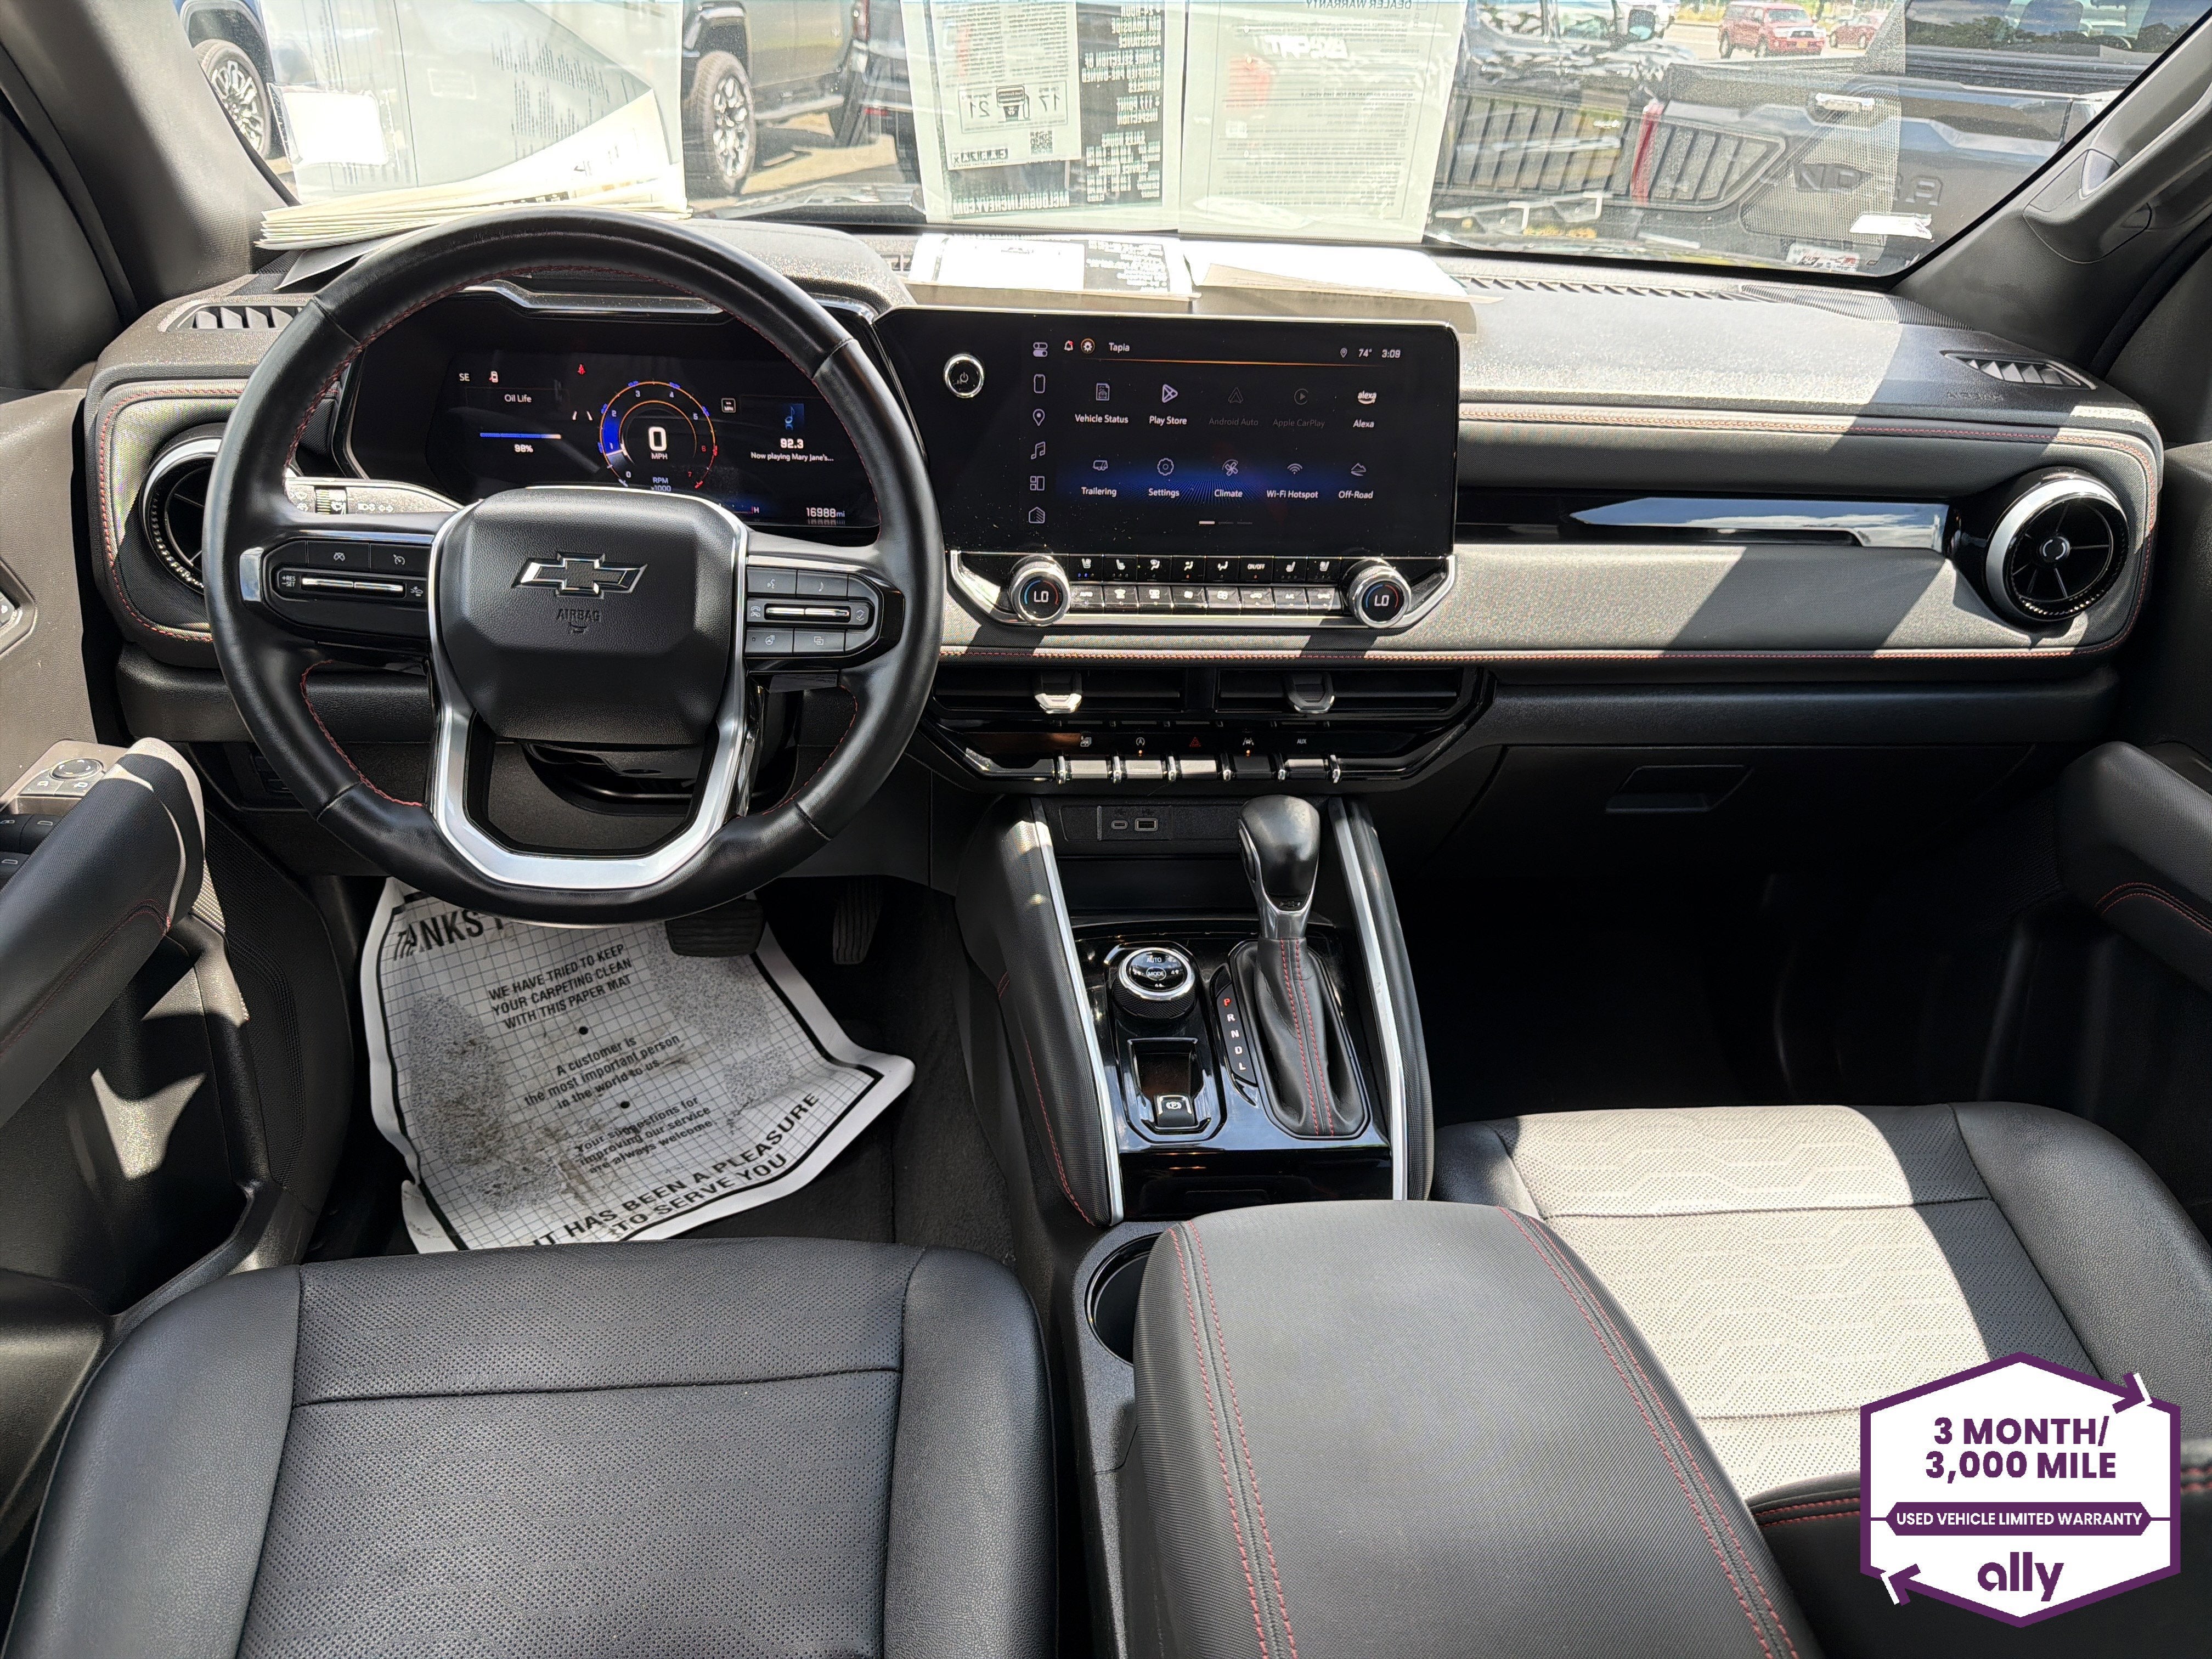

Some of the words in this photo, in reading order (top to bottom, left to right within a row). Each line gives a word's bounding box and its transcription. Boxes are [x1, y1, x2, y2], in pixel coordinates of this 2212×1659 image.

[1109, 342, 1130, 353] Tapia
[1382, 349, 1401, 358] 3:09
[459, 373, 470, 381] SE
[504, 394, 516, 402] Oil
[517, 394, 532, 403] Life
[1357, 390, 1377, 399] alexa
[1075, 414, 1102, 423] Vehicle
[1104, 414, 1128, 424] Status
[1149, 415, 1165, 426] Play
[1166, 416, 1187, 425] Store
[1209, 417, 1239, 426] Android
[1240, 418, 1259, 426] Auto
[1273, 419, 1294, 428] Apple
[1296, 419, 1325, 429] CarPlay
[1353, 419, 1375, 428] Alexa
[648, 427, 667, 452] 0
[780, 438, 804, 449] 92.3
[514, 444, 533, 453] 98%
[751, 452, 766, 460] Now
[768, 452, 791, 461] playing
[792, 454, 808, 462] Mary
[1081, 487, 1117, 498] Trailering
[1148, 488, 1180, 499] Settings
[1214, 489, 1243, 498] Climate
[1266, 489, 1286, 498] Wi-Fi
[1288, 490, 1318, 500] Hotspot
[1338, 490, 1374, 499] Off-Road
[1034, 591, 1048, 602] LO
[1374, 595, 1390, 607] LO
[556, 608, 600, 622] AIRBAG
[488, 985, 511, 1001] WE
[512, 974, 545, 994] HAVE
[546, 962, 578, 982] TRIED
[579, 955, 595, 968] TO
[597, 944, 624, 961] KEEP
[491, 997, 528, 1016] YOUR
[531, 972, 594, 1004] CARPETING
[595, 958, 632, 979] CLEAN
[503, 1011, 537, 1029] WITH
[538, 999, 567, 1018] THIS
[568, 985, 606, 1006] PAPER
[607, 974, 631, 991] MAT
[1223, 998, 1231, 1006] P
[1227, 1014, 1235, 1022] R
[1231, 1030, 1239, 1038] N
[1235, 1046, 1243, 1054] D
[1239, 1062, 1246, 1070] L
[557, 1065, 567, 1076] A
[568, 1042, 623, 1070] customer
[624, 1036, 637, 1047] is
[524, 1091, 544, 1107] the
[548, 1077, 579, 1097] most
[579, 1052, 640, 1083] important
[640, 1035, 680, 1060] person
[557, 1098, 571, 1109] in
[572, 1089, 592, 1103] the
[595, 1072, 629, 1093] world
[629, 1067, 644, 1077] to
[645, 1059, 660, 1072] us
[574, 1136, 605, 1153] Your
[607, 1105, 680, 1139] suggestions
[680, 1097, 698, 1109] for
[579, 1134, 644, 1166] improving
[645, 1125, 665, 1138] our
[667, 1107, 712, 1130] service
[589, 1161, 610, 1173] are
[612, 1143, 657, 1165] always
[563, 1210, 618, 1238] HAS
[622, 1179, 687, 1211] BEEN
[692, 1172, 709, 1183] A
[712, 1092, 821, 1173] PLEASURE
[612, 1214, 648, 1231] TO
[654, 1176, 736, 1215] SERVE
[736, 1153, 787, 1182] YOU
